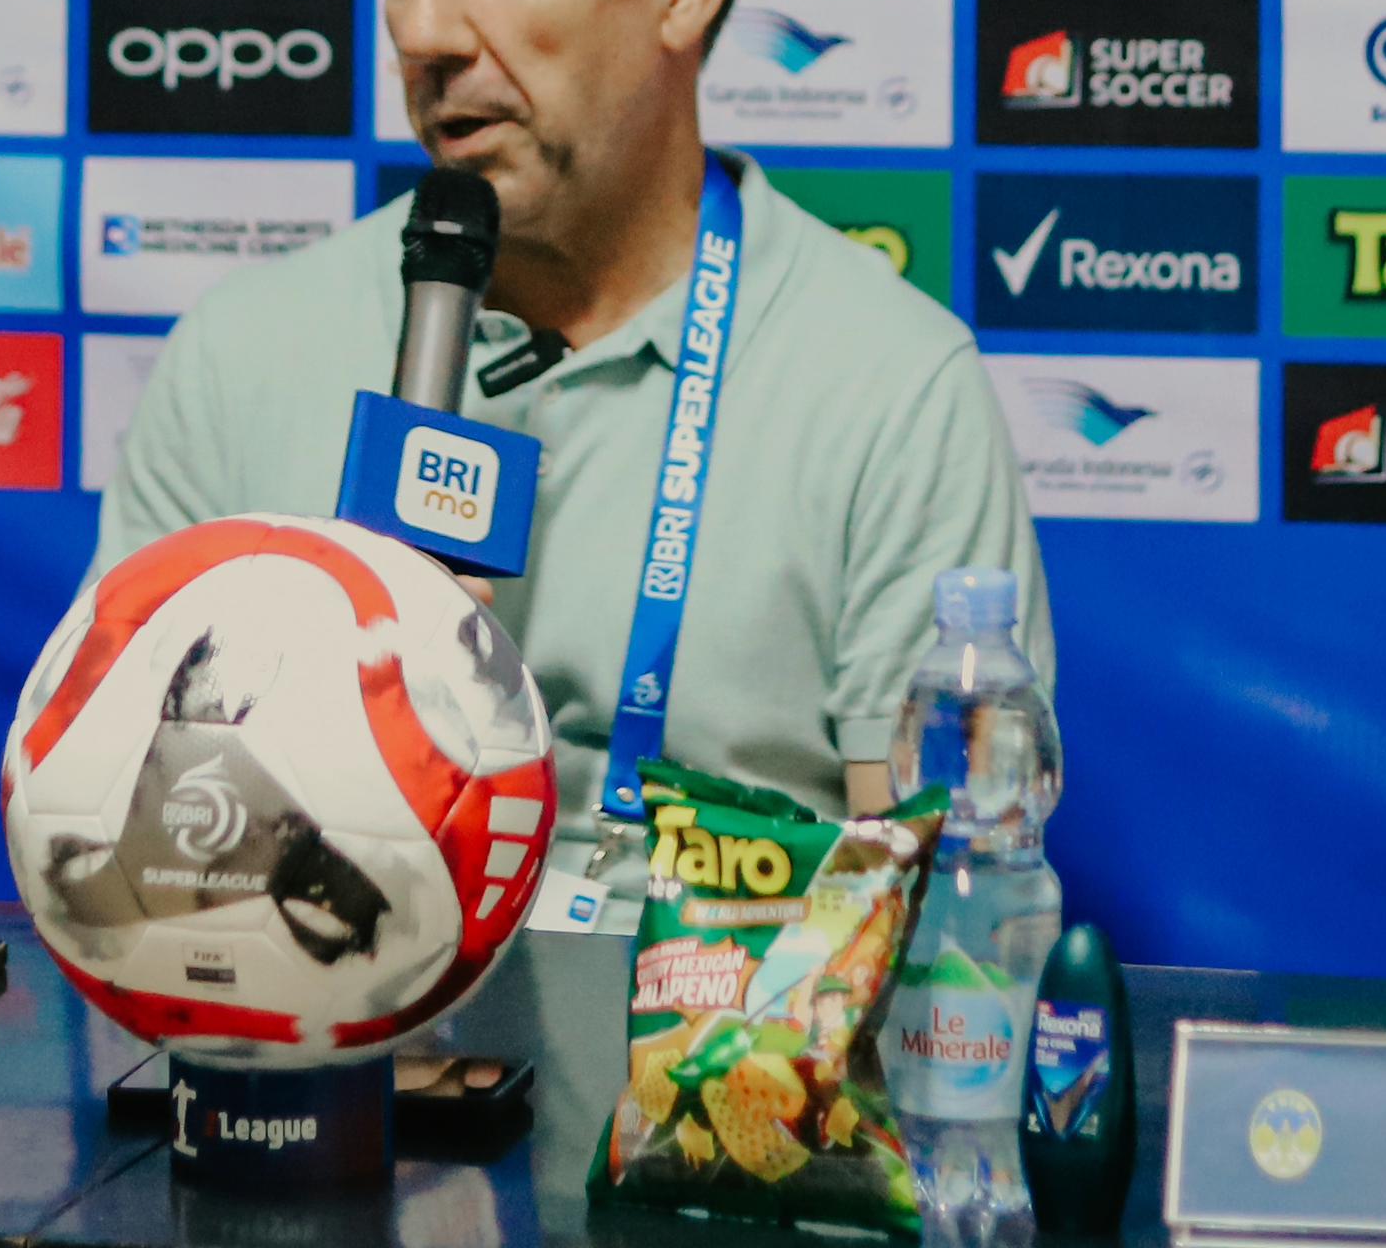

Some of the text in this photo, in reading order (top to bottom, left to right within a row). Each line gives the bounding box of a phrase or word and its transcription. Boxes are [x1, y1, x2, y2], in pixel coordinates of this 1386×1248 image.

[109, 28, 333, 91] oppo
[1091, 40, 1205, 71] SUPER
[1091, 72, 1232, 107] SOCCER
[1060, 240, 1240, 291] Rexona
[417, 449, 481, 497] BRI
[424, 490, 479, 521] mo
[655, 508, 693, 564] BRI
[649, 805, 793, 896] Taro
[671, 948, 748, 973] MEXICAN
[631, 972, 739, 1011] JALAPENO
[932, 1007, 965, 1036] Le
[1037, 1013, 1102, 1040] Rexona
[900, 1027, 1011, 1062] Minerale
[216, 1111, 317, 1150] League
